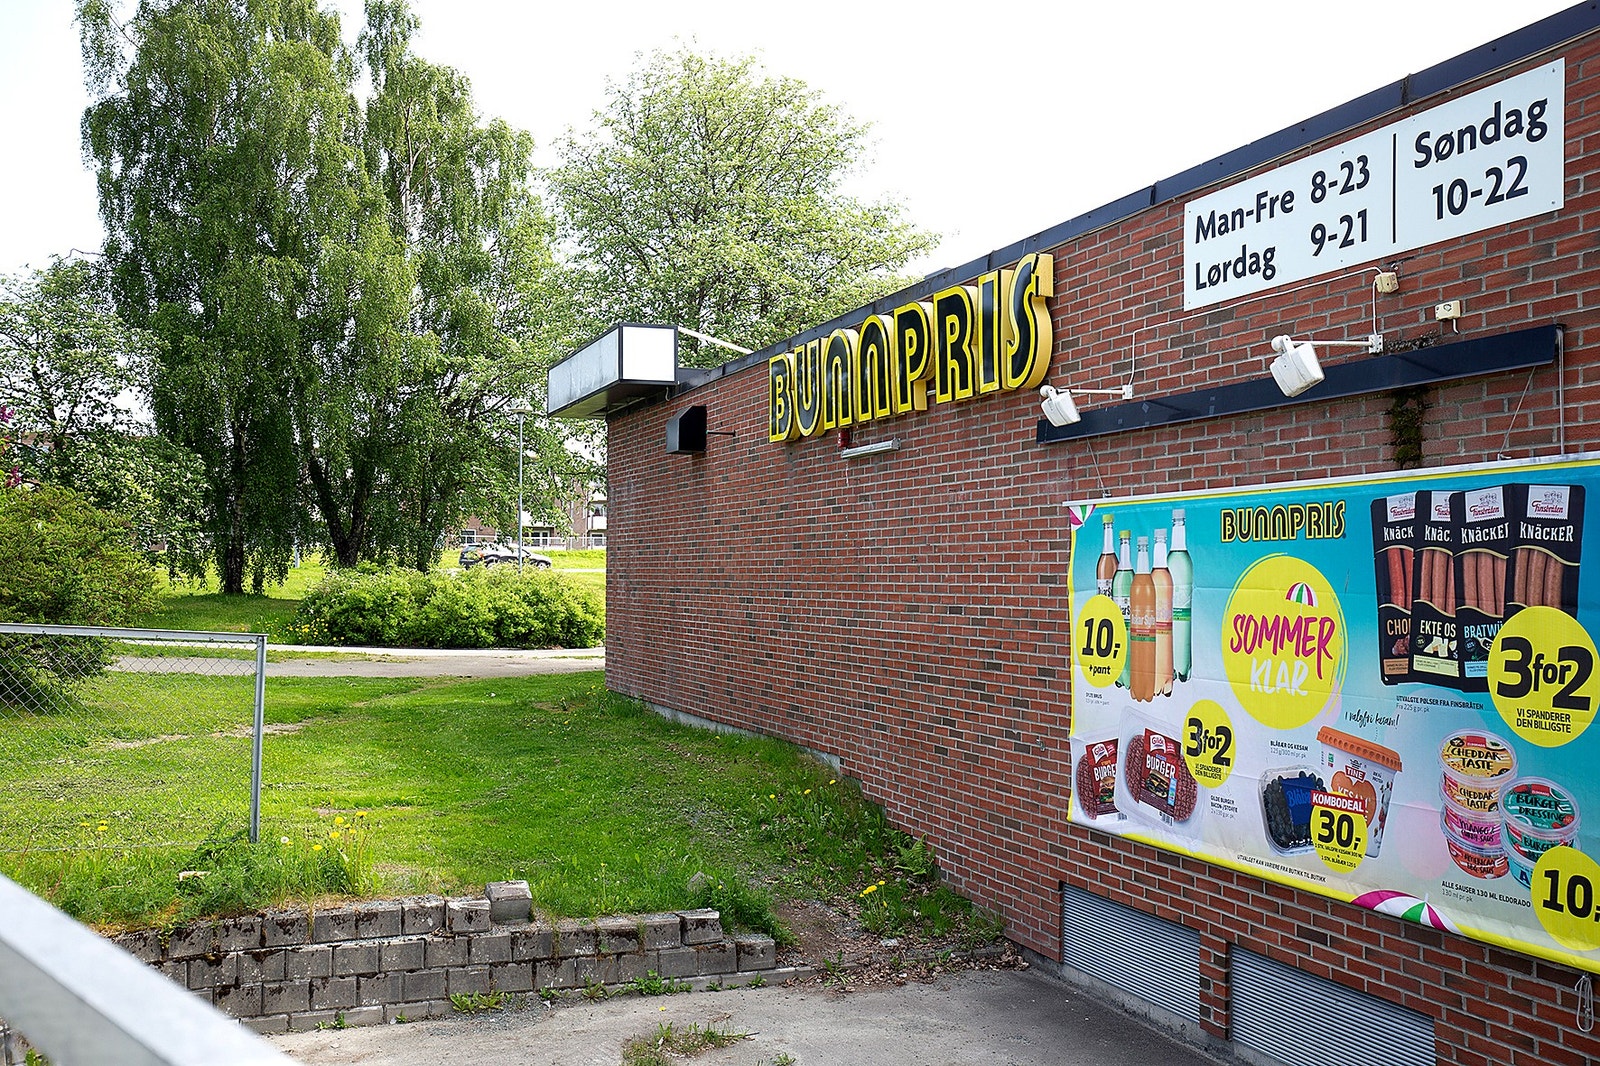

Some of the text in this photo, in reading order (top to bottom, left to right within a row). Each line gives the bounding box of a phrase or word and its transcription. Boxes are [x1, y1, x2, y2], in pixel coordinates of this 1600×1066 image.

[1414, 98, 1548, 168] Søndag
[1432, 155, 1529, 220] 10-22
[1195, 154, 1370, 244] Man-Fre 8-23
[1195, 208, 1368, 290] Lørdag 9-21
[769, 253, 1054, 443] BUNNPRIS
[1220, 500, 1346, 543] BUNNPRIS
[1424, 524, 1453, 542] KNäC
[1420, 620, 1442, 636] EKTE
[1230, 613, 1336, 681] SOMMER
[1250, 656, 1309, 697] KLAR
[1439, 699, 1450, 707] FRA
[1517, 708, 1571, 723] VI SPANDERER
[1516, 718, 1572, 733] DEN BILLIGSTE
[1451, 747, 1501, 761] CHEDDAR
[1146, 754, 1176, 779] BURGER
[1460, 758, 1493, 770] TASTE
[1347, 767, 1364, 780] TINE
[1312, 793, 1364, 812] KOMBODEAL
[1459, 788, 1494, 800] CHEDDAR
[1466, 798, 1488, 809] TASTE
[1441, 888, 1452, 897] 130
[1442, 881, 1531, 908] ALLE SAUSER 130 ML ELDORADO
